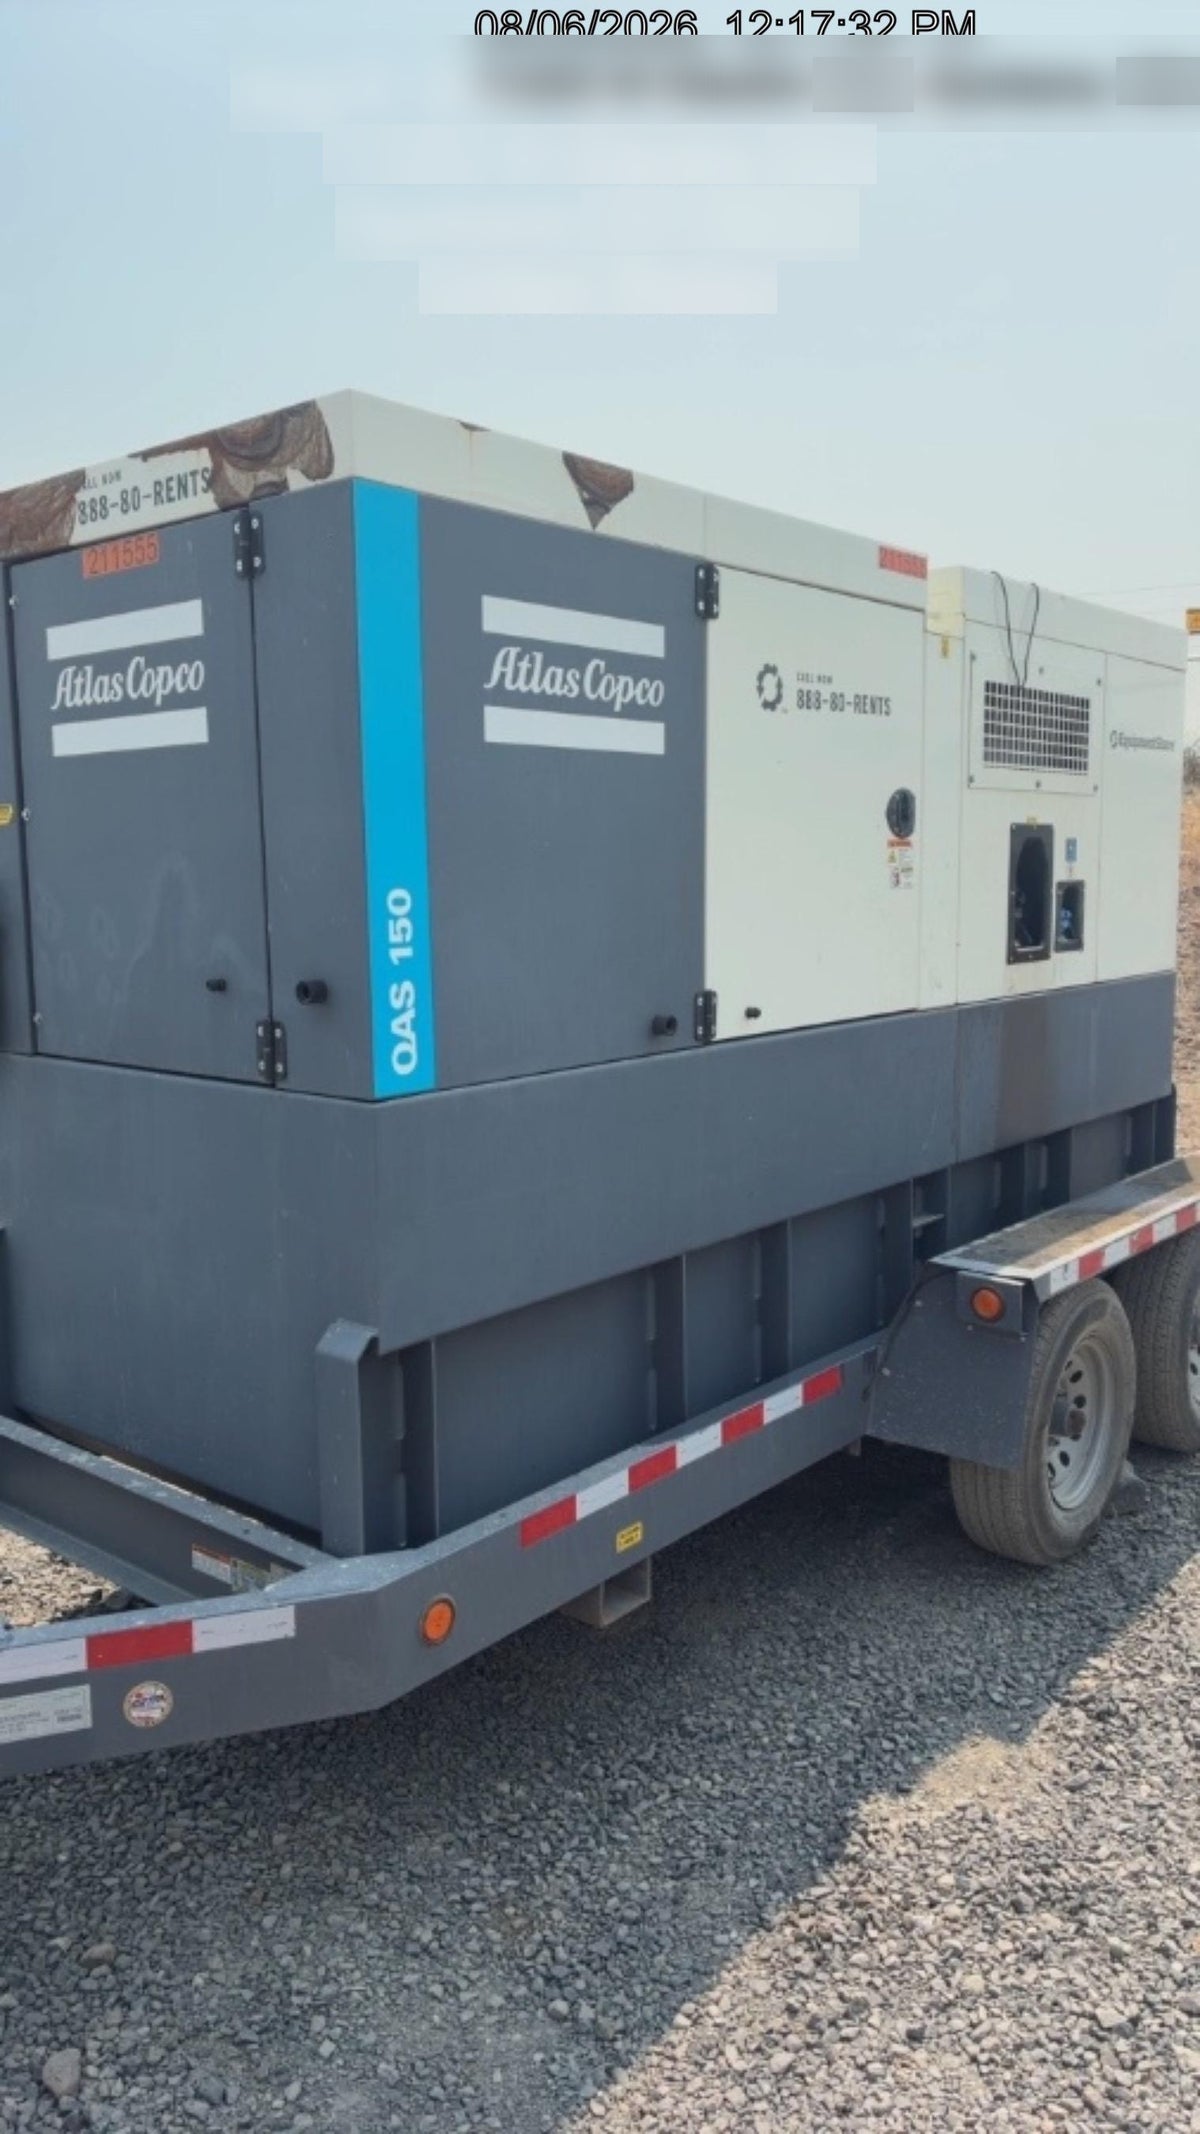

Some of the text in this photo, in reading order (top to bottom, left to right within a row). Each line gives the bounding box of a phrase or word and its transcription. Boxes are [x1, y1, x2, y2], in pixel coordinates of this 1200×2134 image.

[77, 467, 211, 525] 888-80-RENTS
[87, 533, 158, 575] 211555
[50, 656, 205, 710] Atlas Copco
[483, 646, 665, 713] Atlas Copco
[796, 689, 892, 716] 888-80-RENTS
[386, 888, 418, 1076] QAS 150
